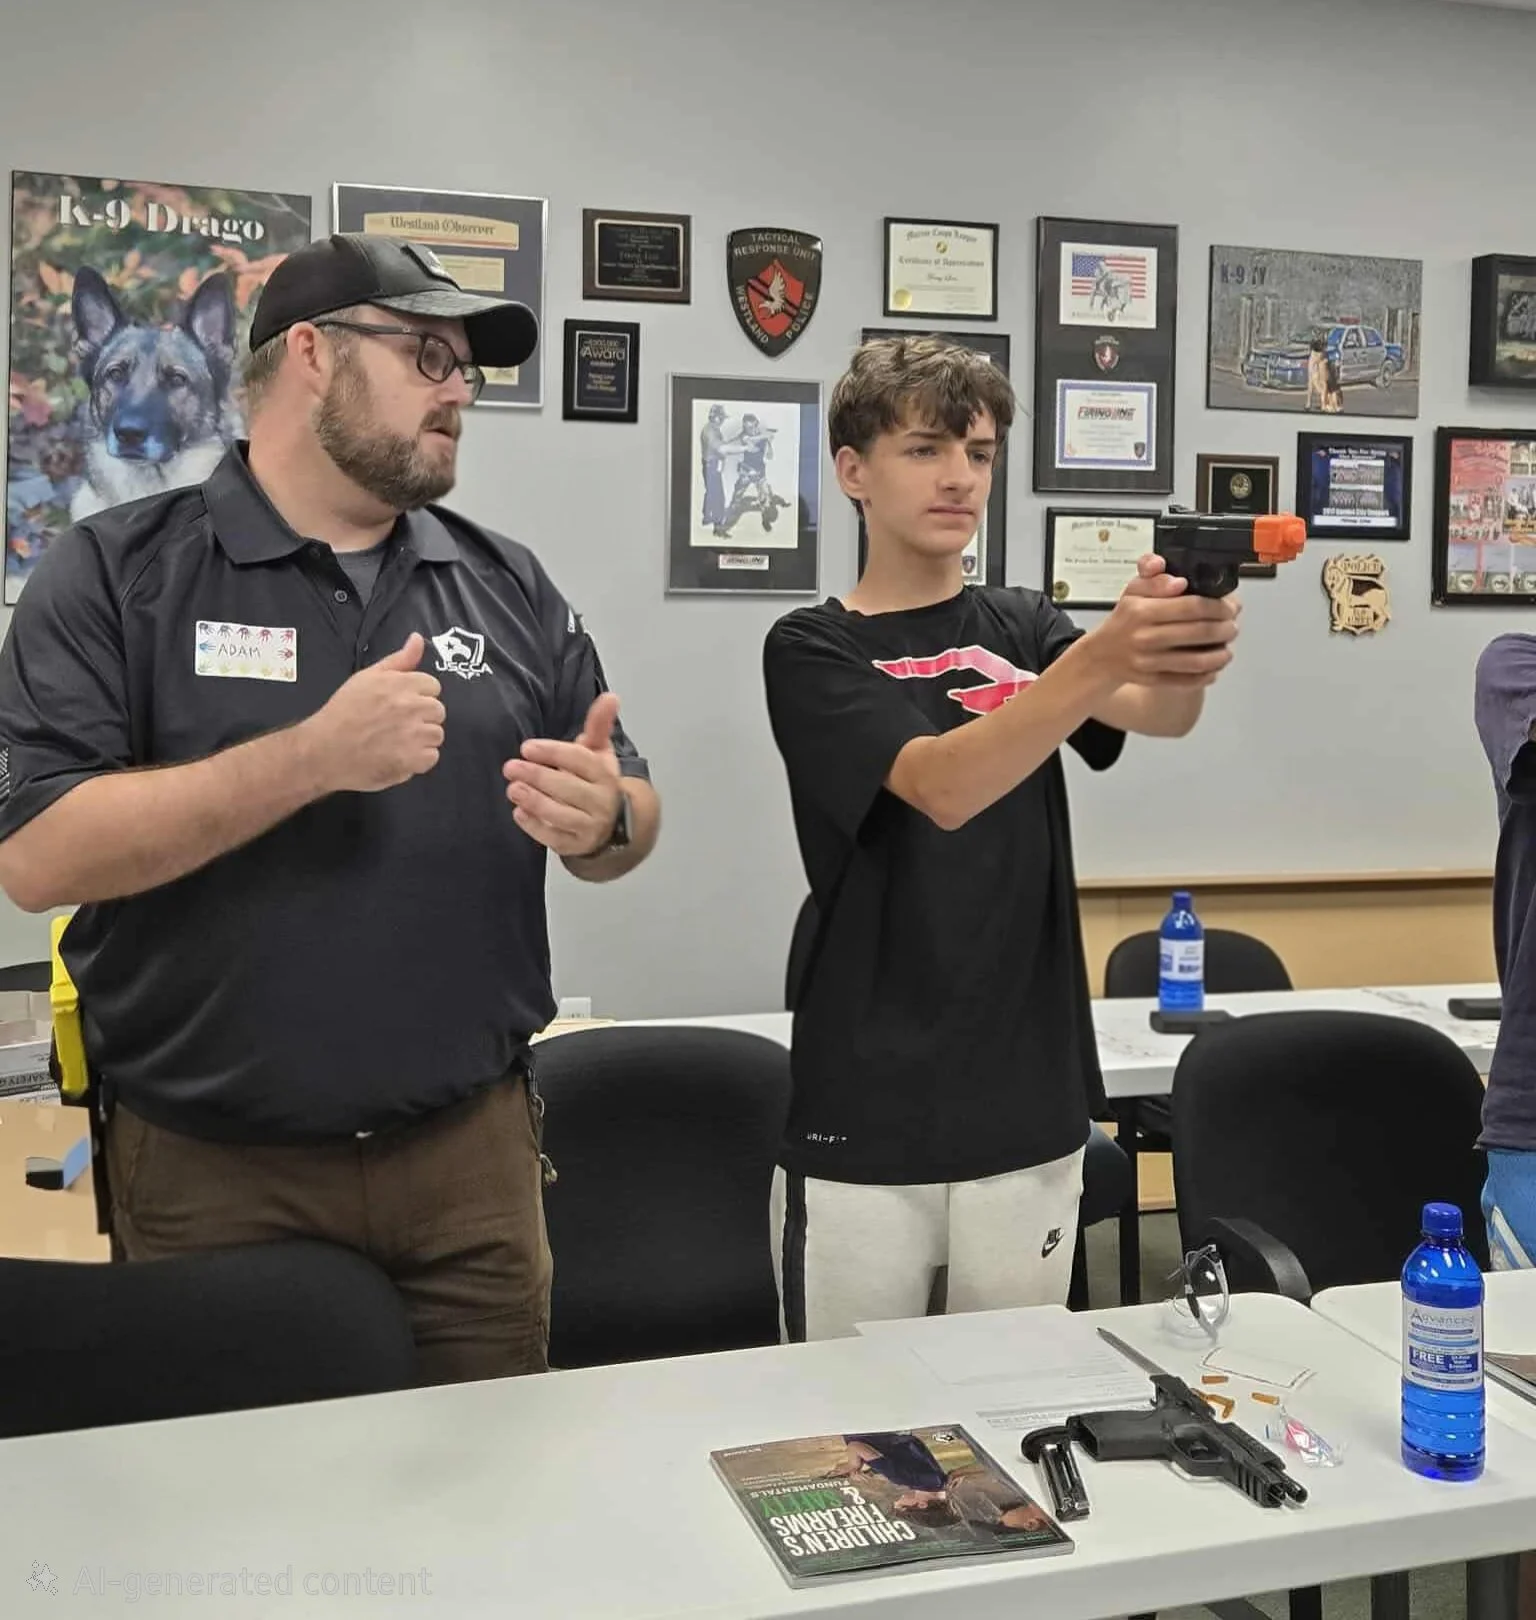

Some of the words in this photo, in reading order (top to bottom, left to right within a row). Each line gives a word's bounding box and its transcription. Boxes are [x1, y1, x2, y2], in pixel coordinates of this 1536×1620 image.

[59, 195, 132, 231] K-9
[147, 202, 265, 244] Drago
[390, 216, 440, 233] Westland
[442, 218, 496, 236] Observer
[751, 233, 800, 245] TACTICAL
[734, 244, 789, 257] RESPONSE
[735, 284, 769, 344] WESTLAND
[784, 292, 814, 341] POLICE
[581, 346, 626, 361] Award
[217, 643, 261, 658] ADAM
[435, 660, 494, 677] USCCA
[1411, 1349, 1445, 1365] FREE
[749, 1480, 850, 1498] FUNDAMENTALS
[839, 1486, 866, 1505] &
[761, 1490, 844, 1518] SAFETY
[769, 1503, 887, 1537] FIREARMS
[782, 1520, 917, 1557] CHILDREN'S
